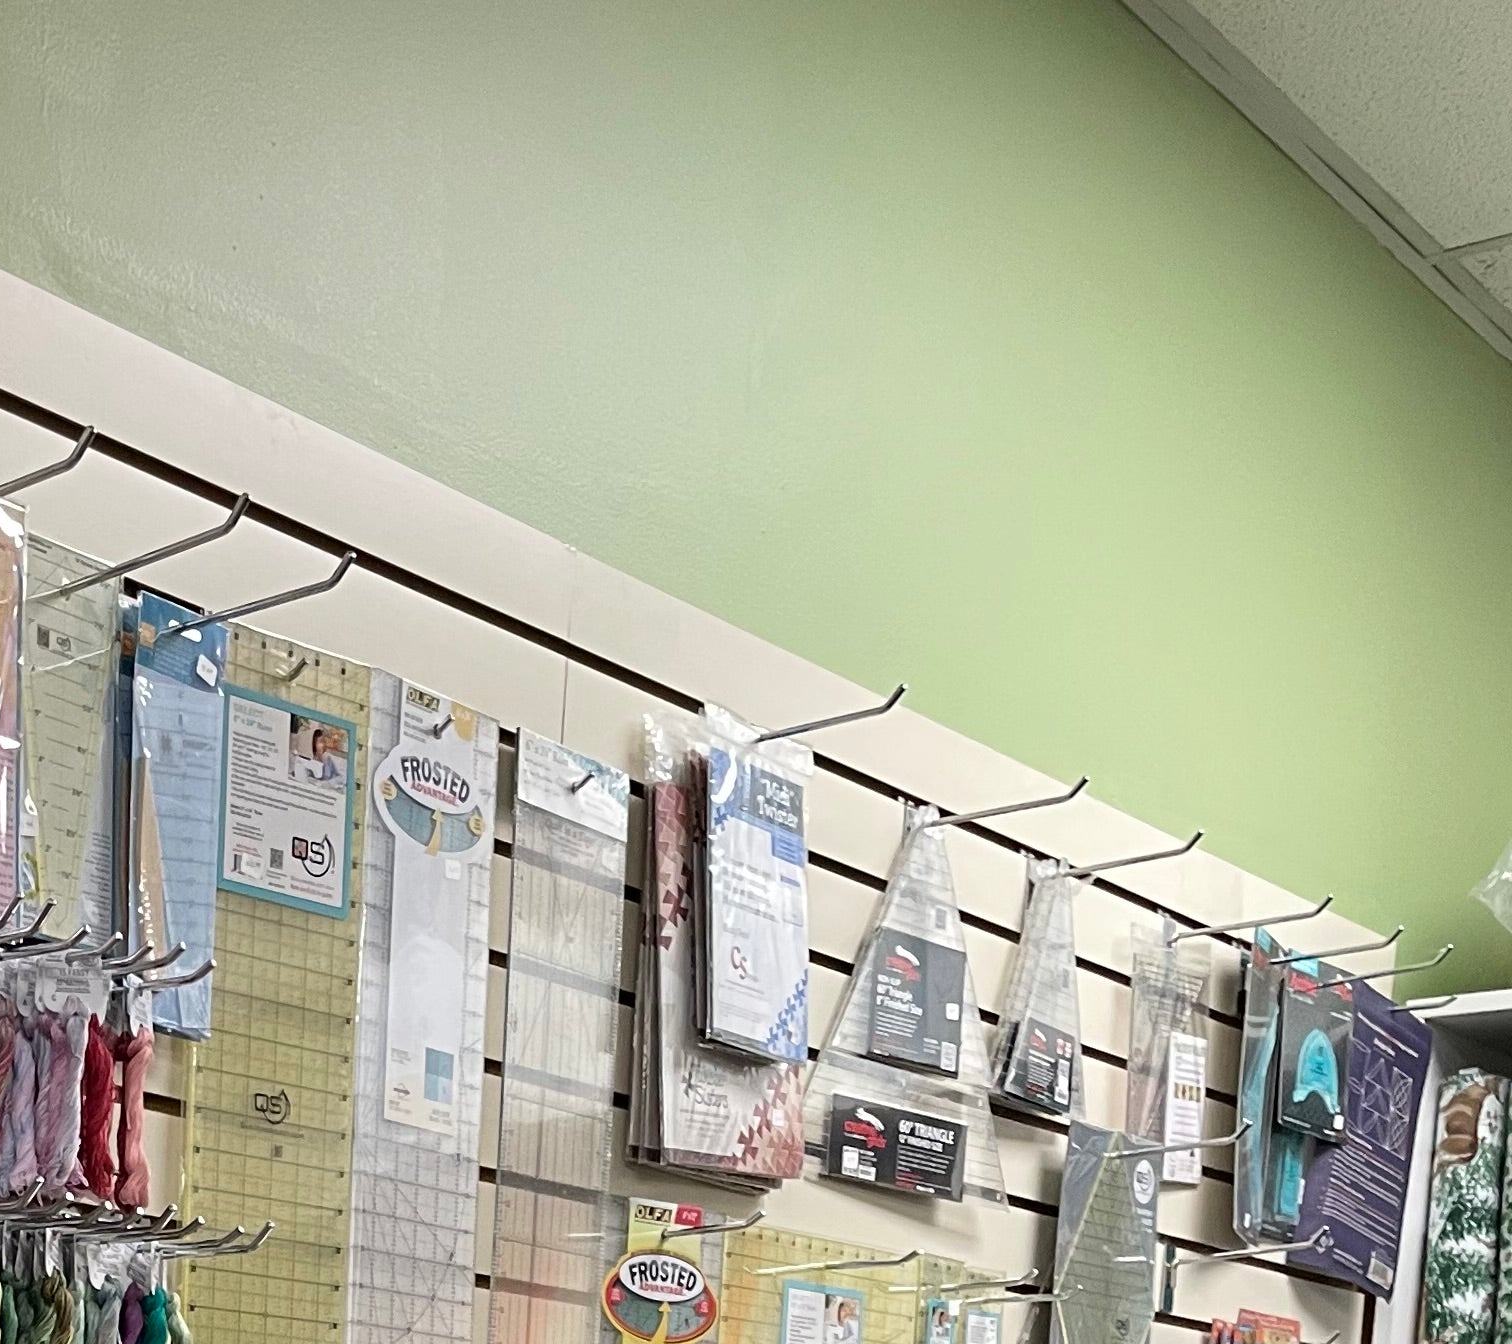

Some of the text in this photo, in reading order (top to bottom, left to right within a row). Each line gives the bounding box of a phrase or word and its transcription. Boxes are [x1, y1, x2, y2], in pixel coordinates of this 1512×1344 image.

[406, 686, 440, 712] OLFA
[400, 756, 470, 804] FROSTED
[635, 1206, 673, 1223] OLFA
[628, 1260, 697, 1291] FROSTED
